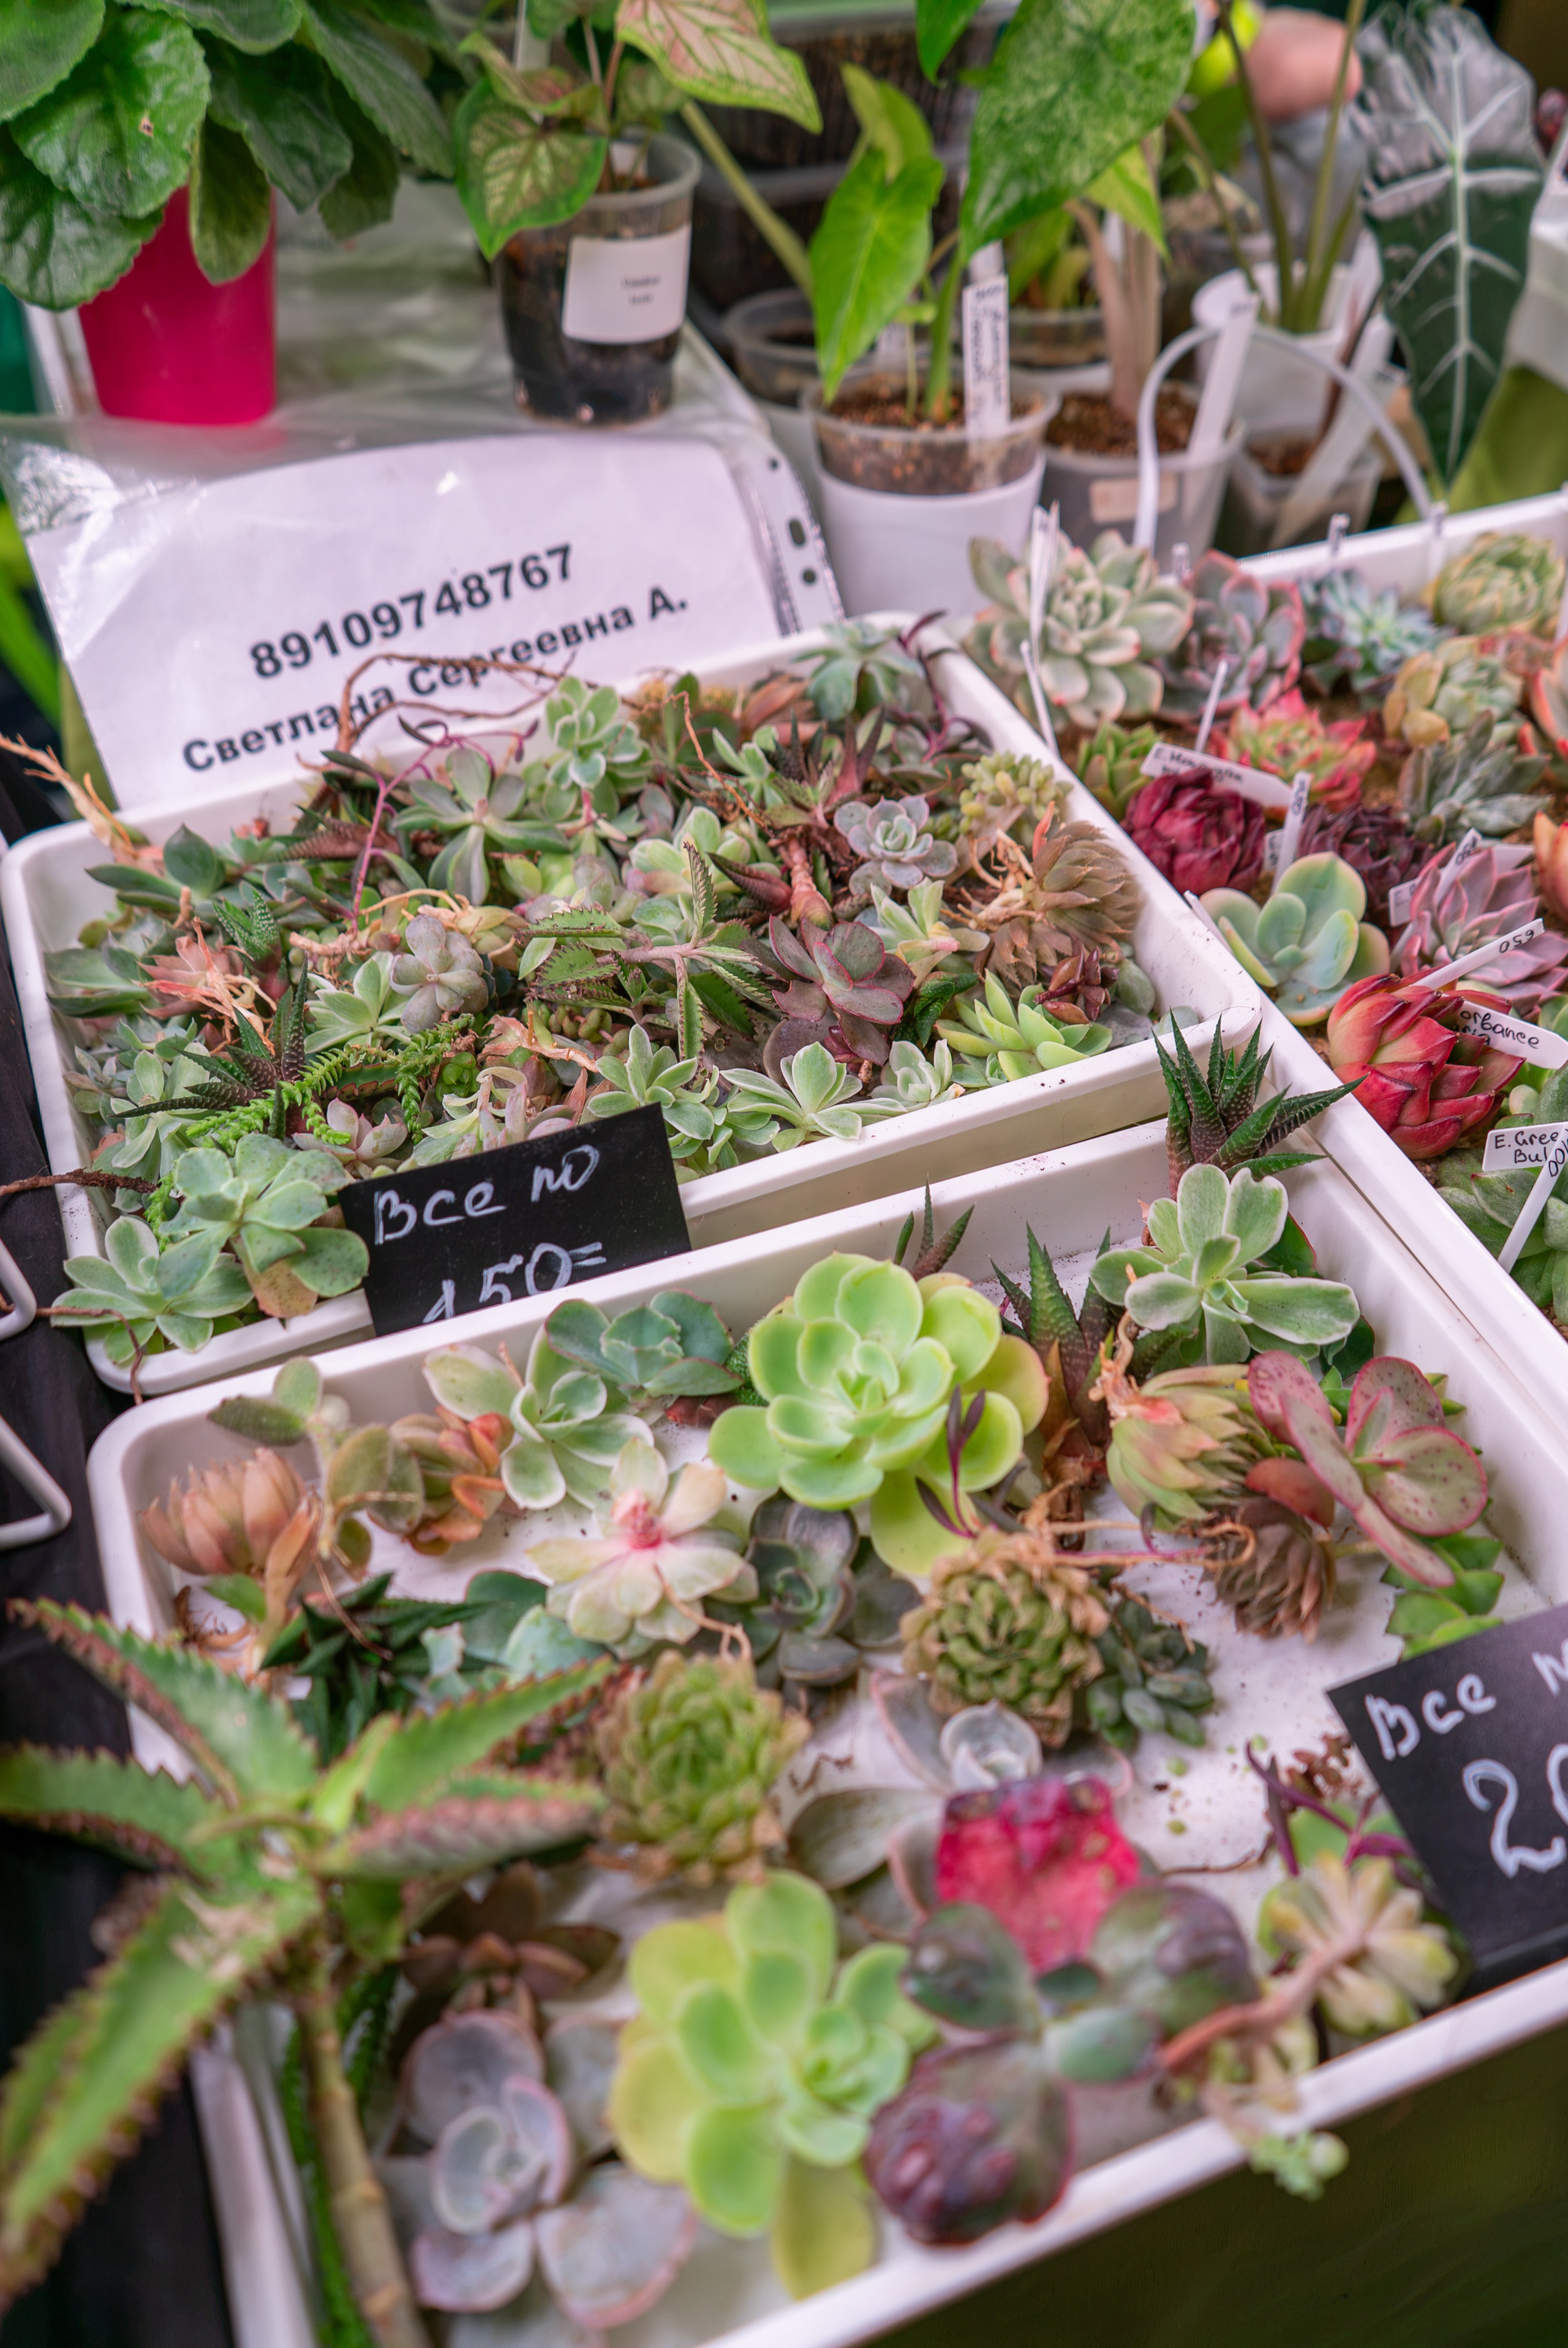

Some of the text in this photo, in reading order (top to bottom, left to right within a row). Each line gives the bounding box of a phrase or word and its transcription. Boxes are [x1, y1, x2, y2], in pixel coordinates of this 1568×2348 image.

[249, 543, 573, 679] 89109748767
[182, 586, 687, 771] Светлана Сергеевна А.
[1499, 929, 1534, 954] 650
[1494, 1130, 1559, 1149] E. Gree
[1513, 1149, 1548, 1164] Bul
[374, 1181, 508, 1246] Все
[1364, 1672, 1497, 1761] Все
